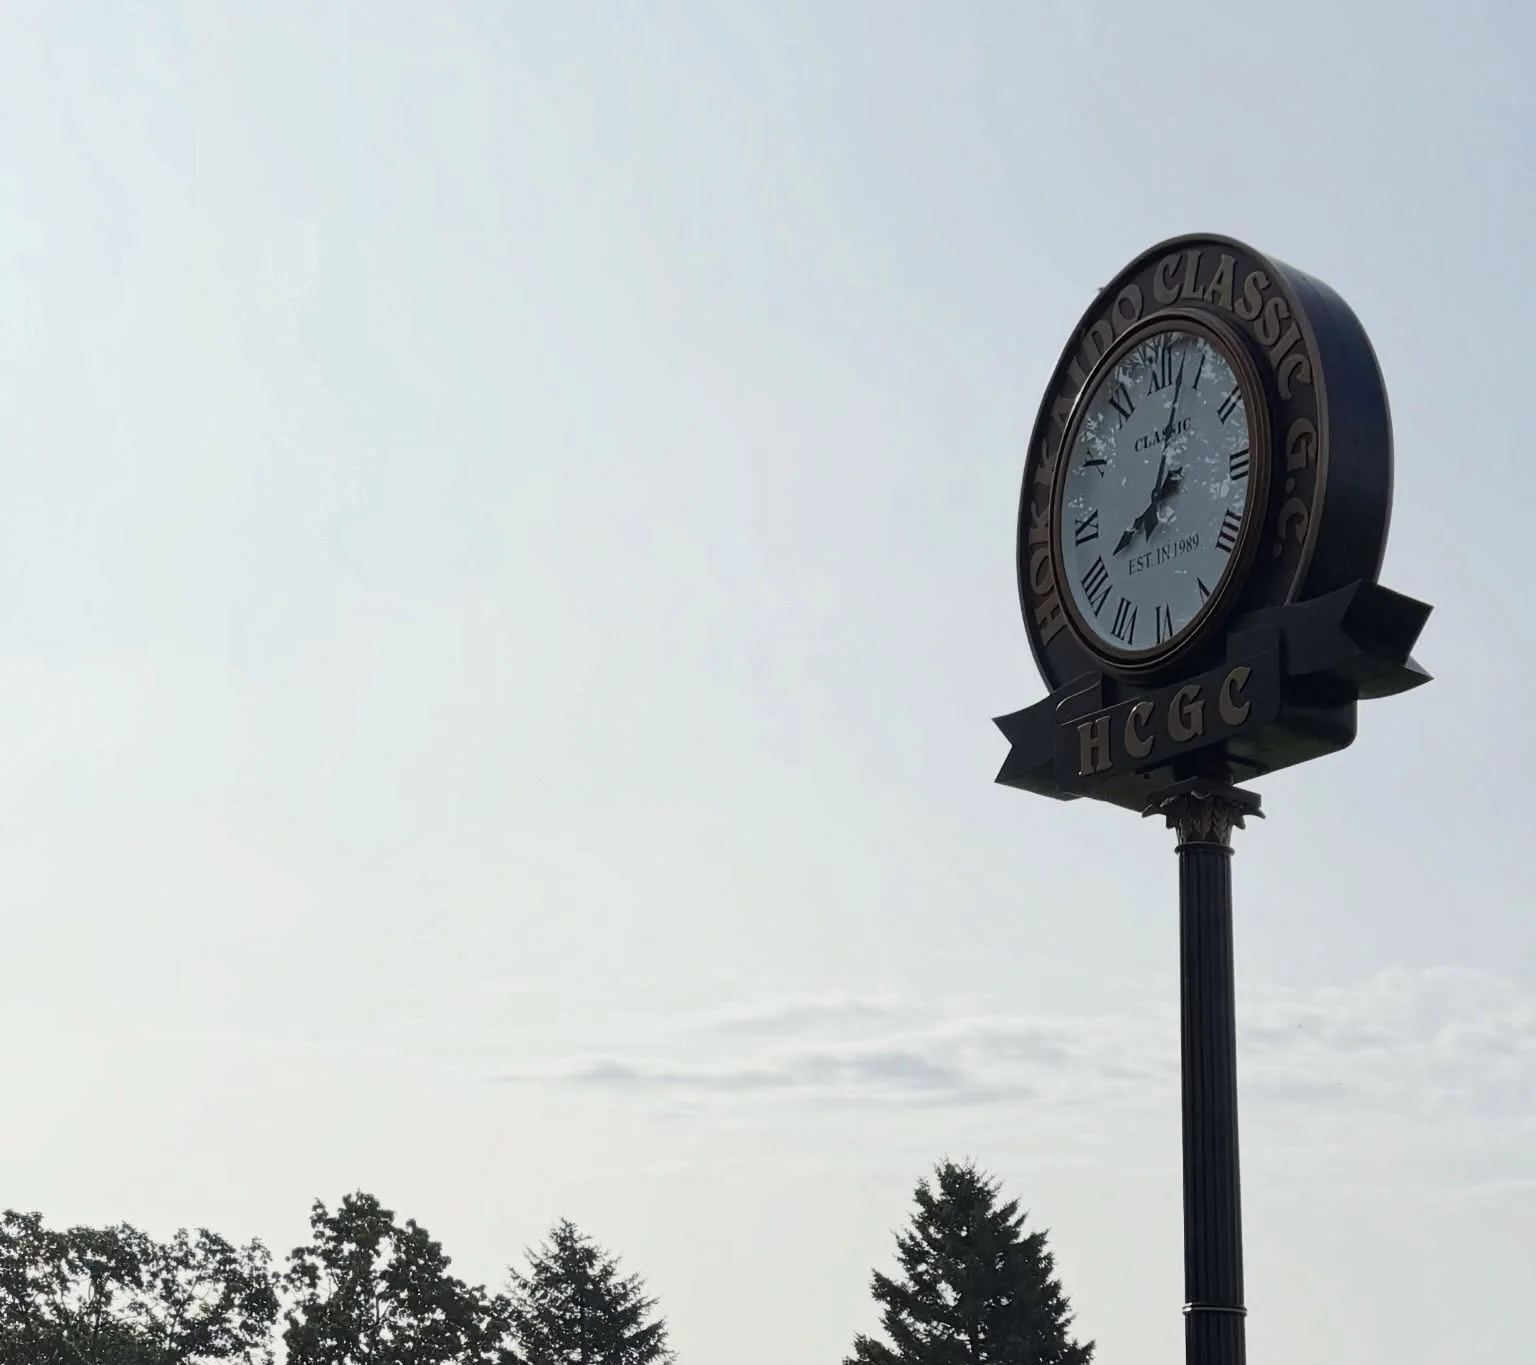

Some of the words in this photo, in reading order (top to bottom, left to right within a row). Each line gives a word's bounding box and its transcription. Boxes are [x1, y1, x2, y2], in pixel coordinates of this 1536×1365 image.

[1154, 250, 1312, 400] CLASSIC
[1128, 551, 1154, 576] EST.
[1157, 545, 1171, 565] IN
[1174, 533, 1200, 560] 1989
[1078, 666, 1252, 777] HCGC
